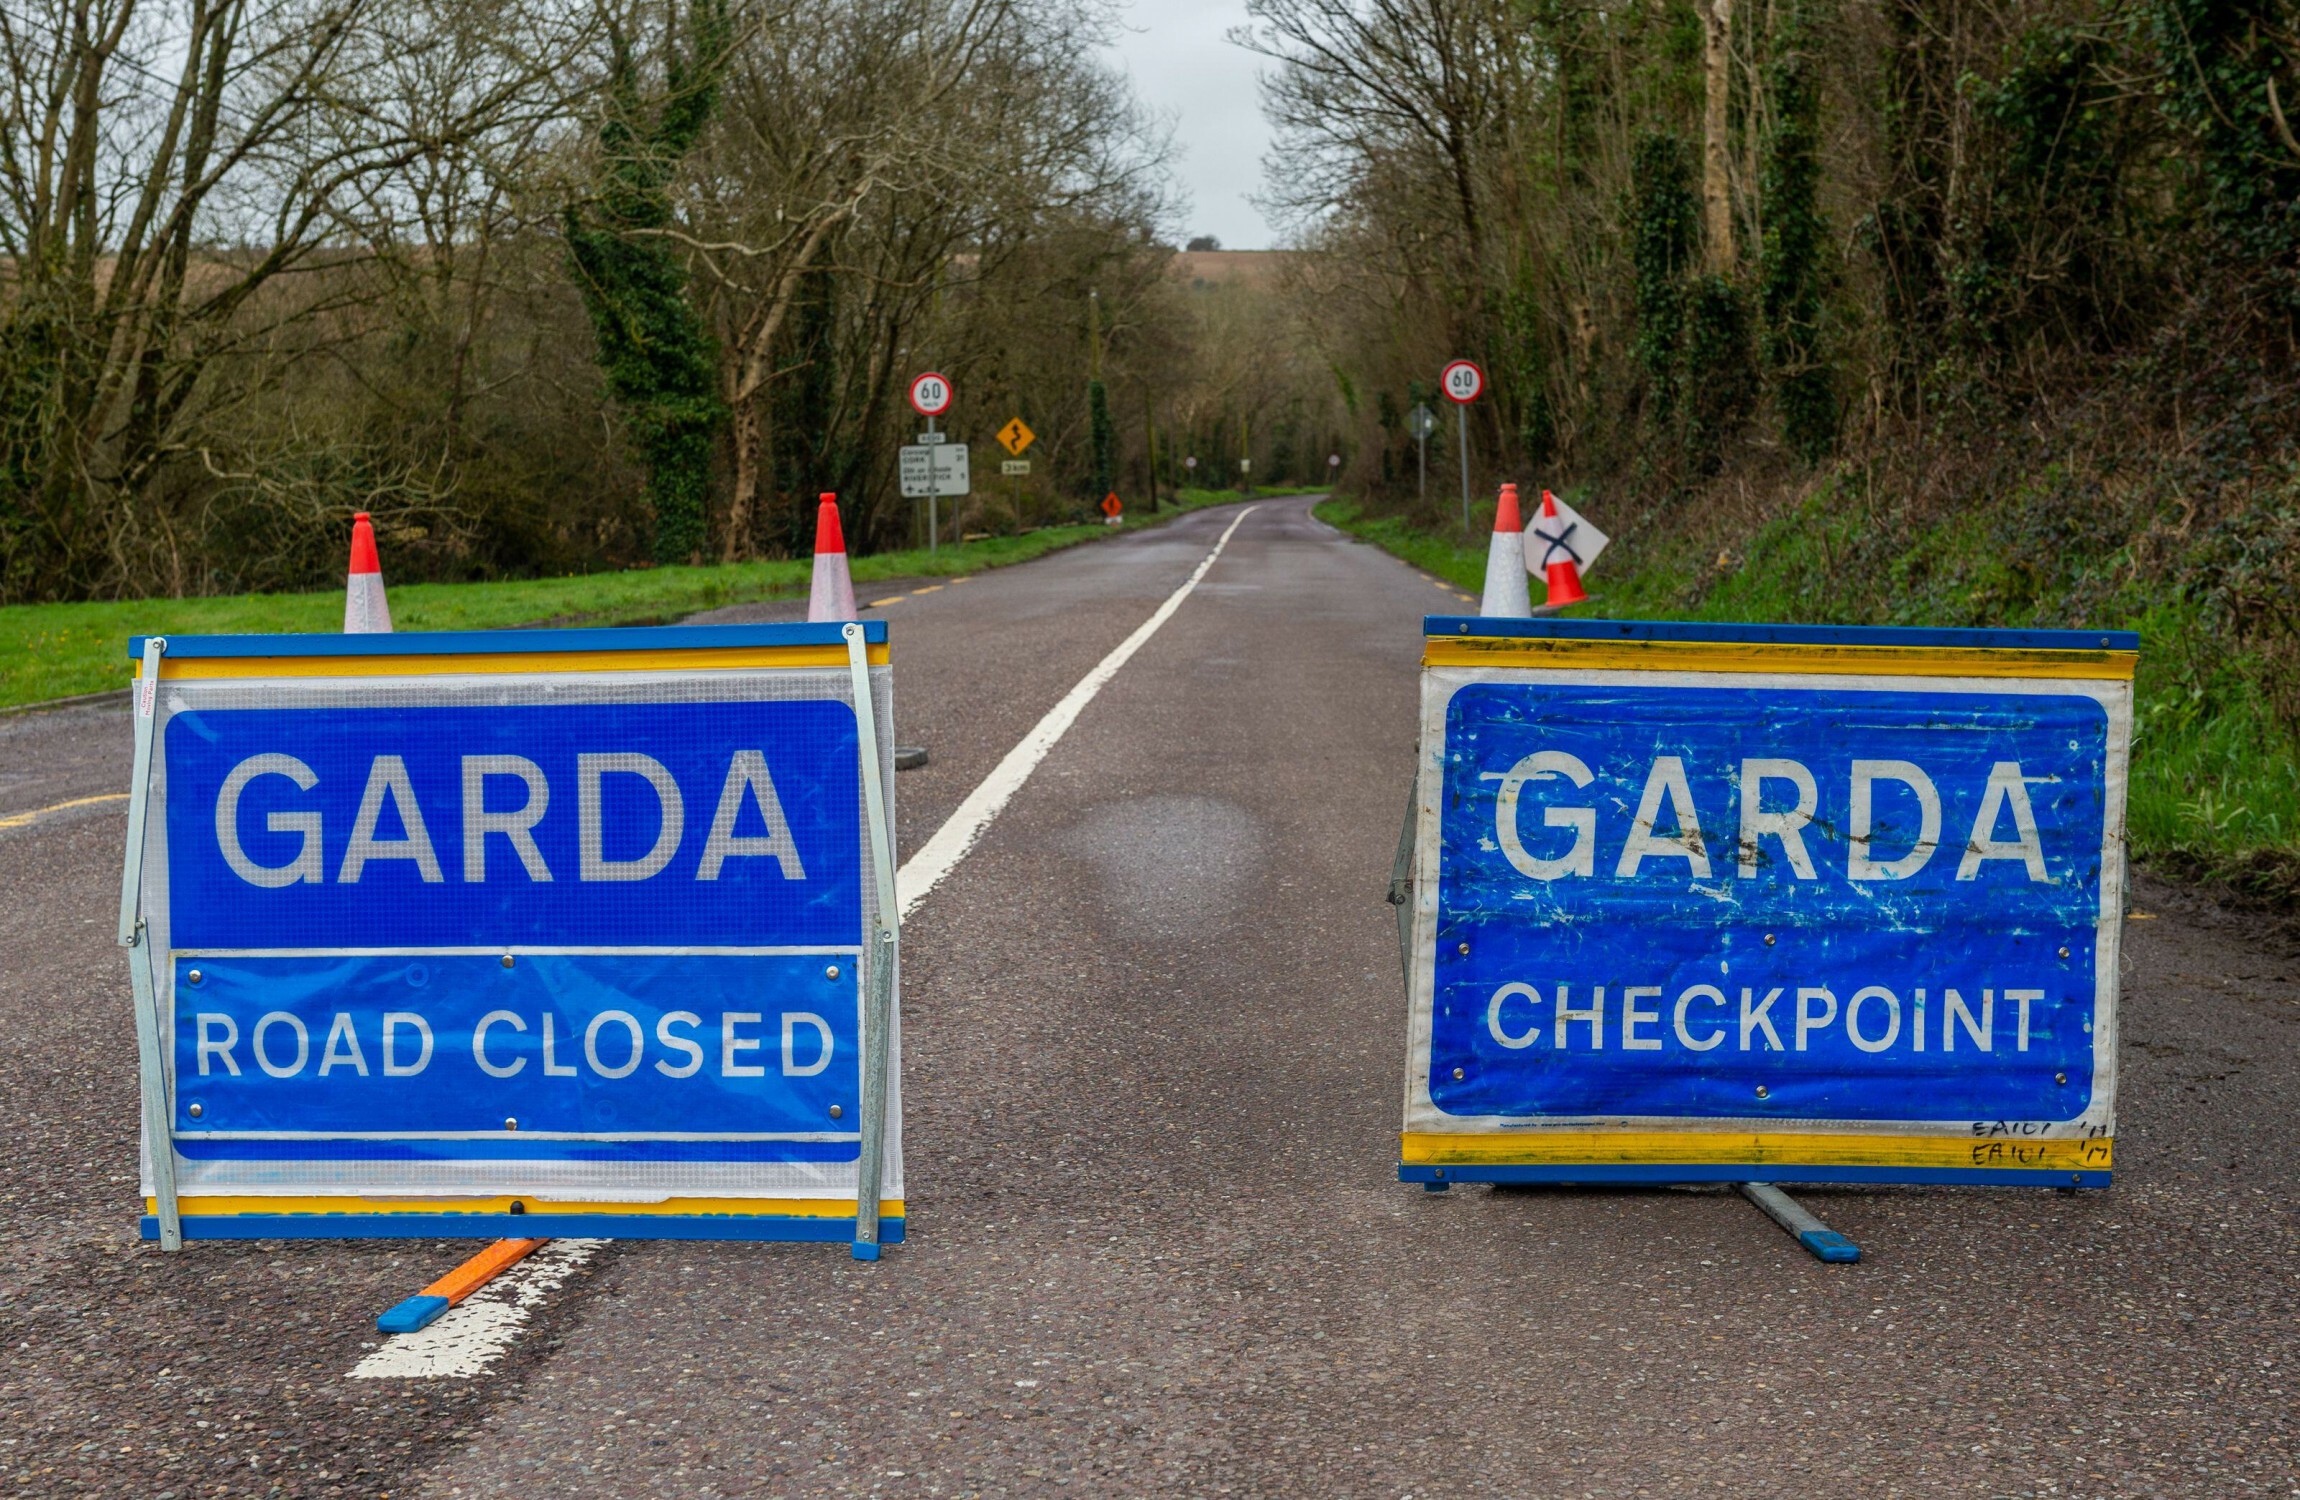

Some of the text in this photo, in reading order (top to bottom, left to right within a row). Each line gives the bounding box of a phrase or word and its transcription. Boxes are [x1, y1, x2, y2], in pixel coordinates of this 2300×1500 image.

[921, 383, 941, 399] 60
[1453, 371, 1473, 387] 60
[216, 751, 805, 887] GARDA
[1495, 751, 2049, 882] GARDA
[197, 1011, 833, 1078] ROAD CLOSED
[1488, 983, 2044, 1052] CHECKPOINT
